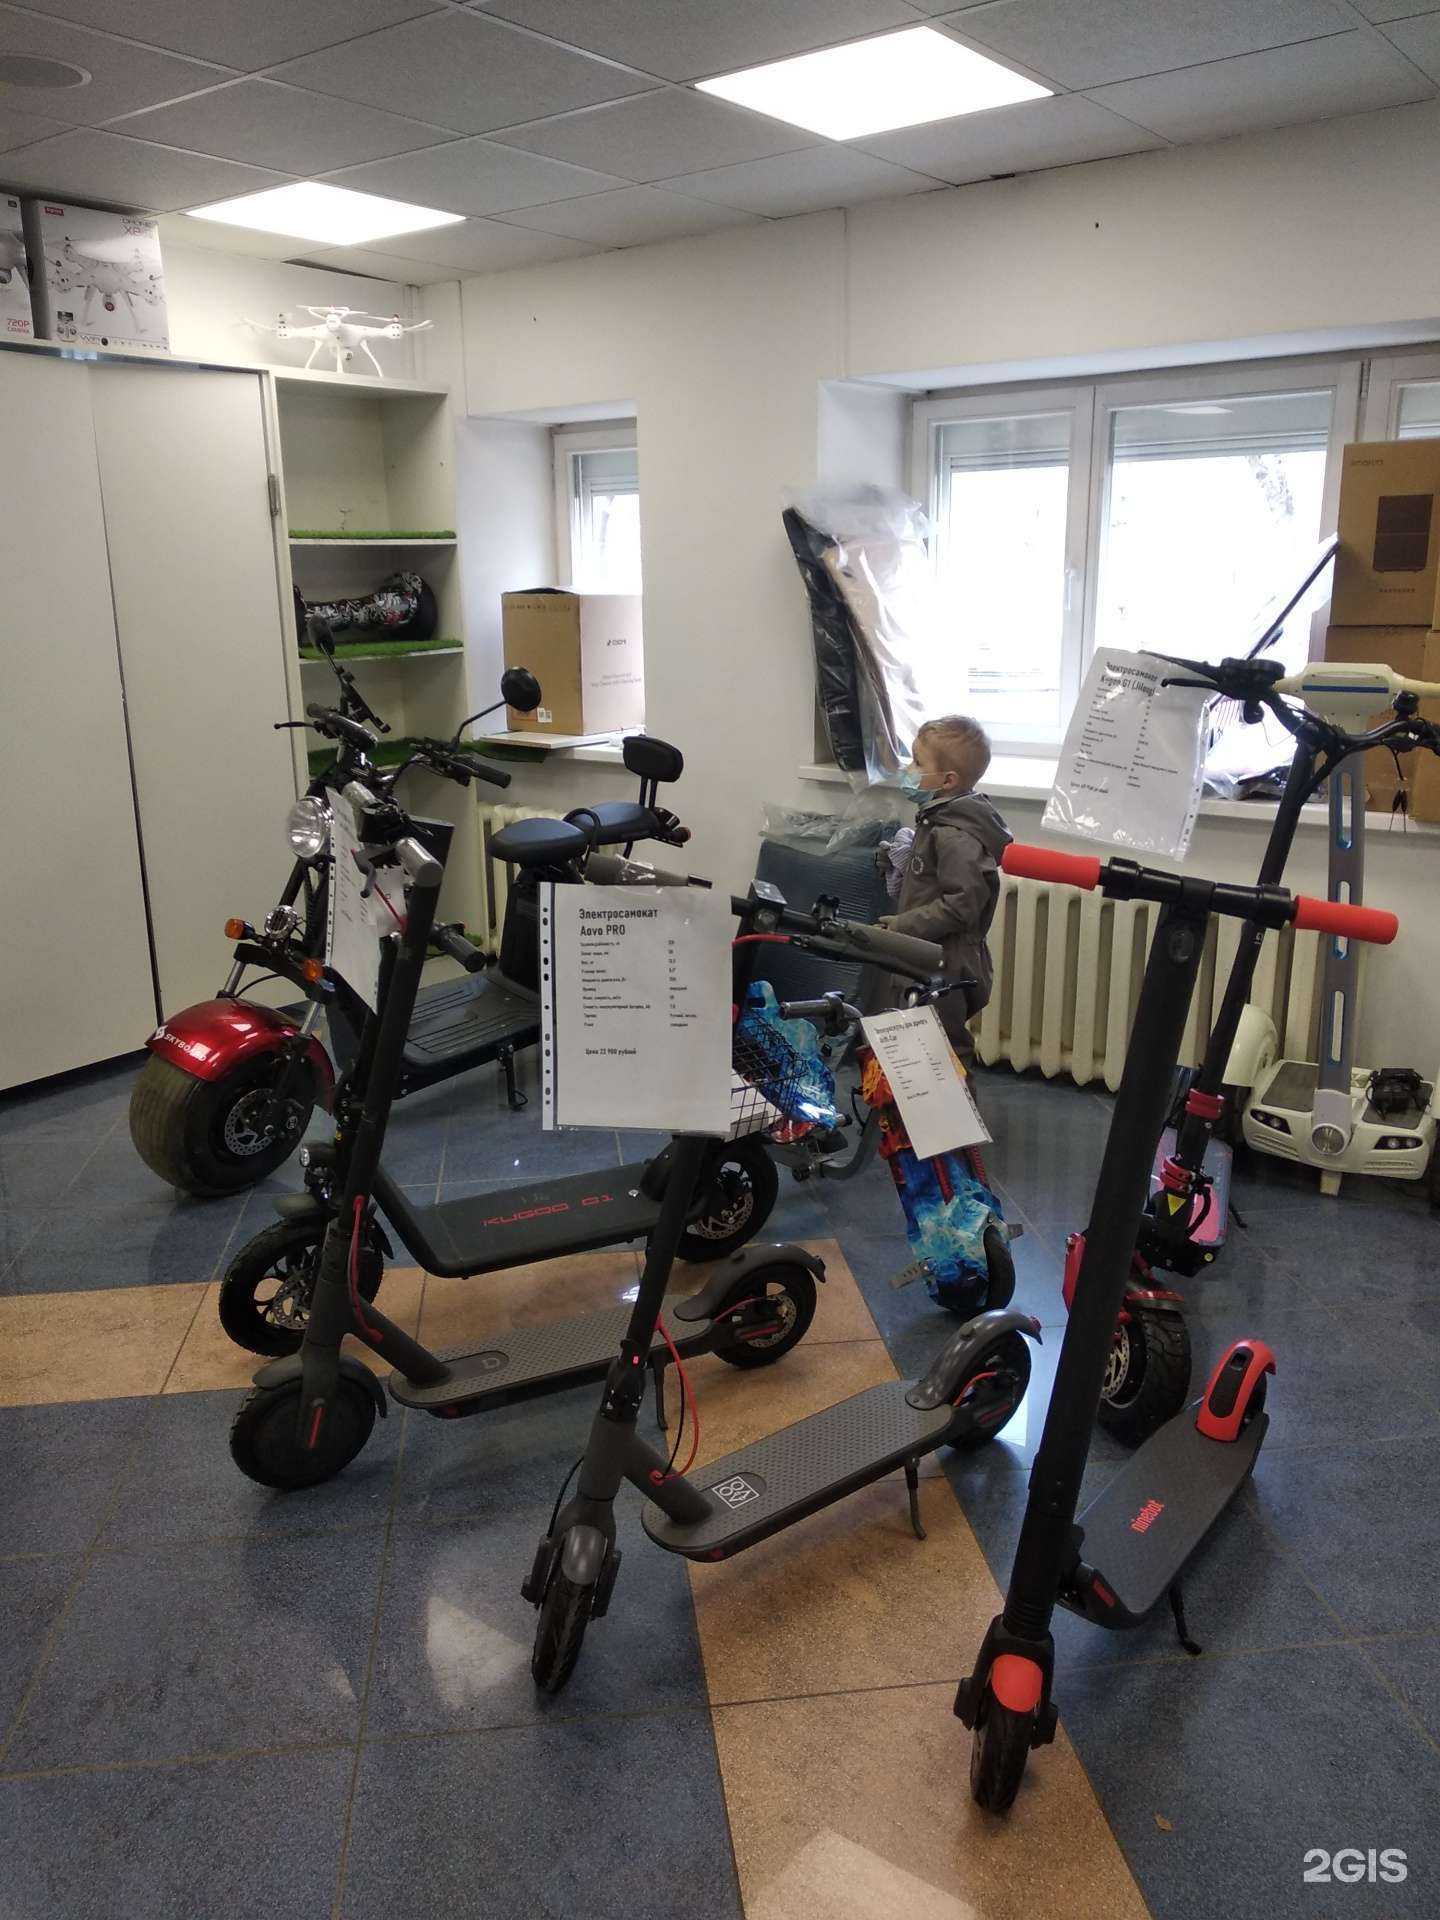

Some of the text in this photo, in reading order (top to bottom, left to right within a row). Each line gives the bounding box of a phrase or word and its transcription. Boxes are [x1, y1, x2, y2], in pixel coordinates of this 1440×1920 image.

[579, 908, 658, 921] Электросамокат
[580, 924, 626, 936] Aovo PRO
[481, 1202, 569, 1226] KUGOO
